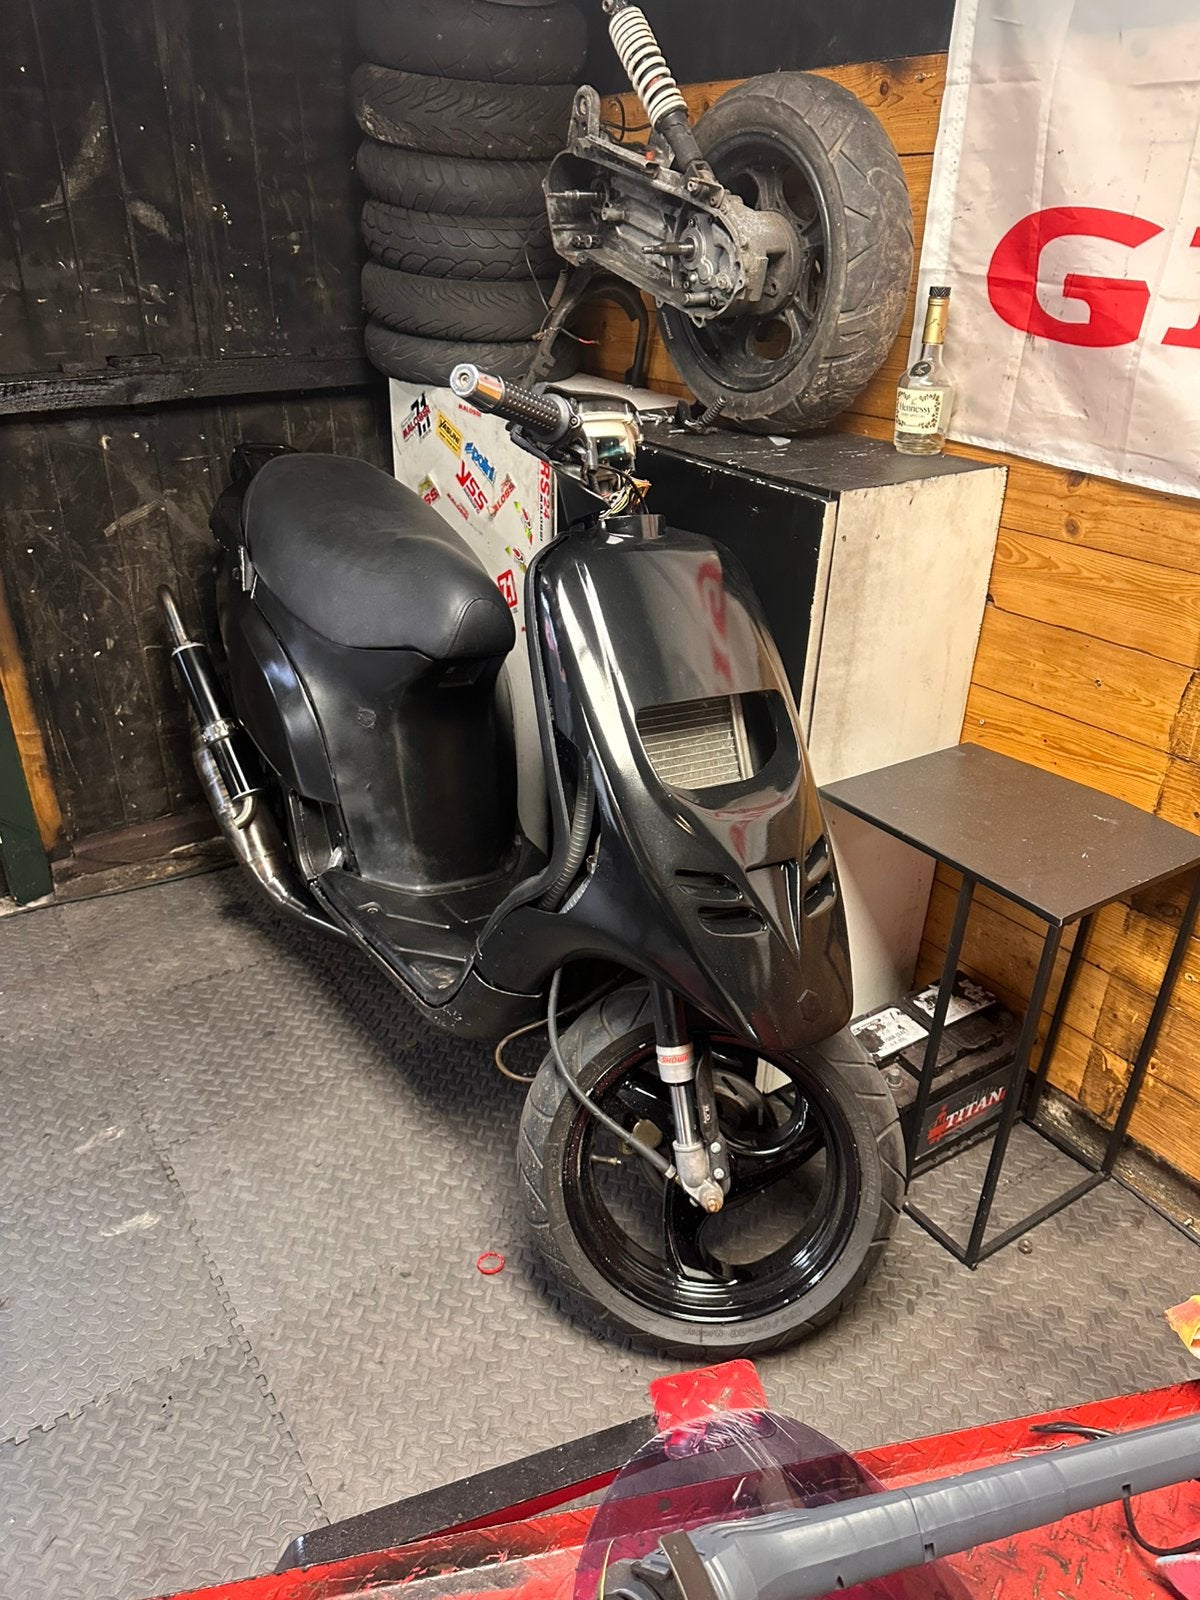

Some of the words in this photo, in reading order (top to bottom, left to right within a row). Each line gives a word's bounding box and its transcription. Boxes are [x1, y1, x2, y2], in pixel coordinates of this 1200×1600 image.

[402, 404, 431, 440] MALOSSI
[899, 403, 931, 415] Hennessy
[438, 418, 461, 445] YASUNI
[945, 1086, 1006, 1130] TITAN
